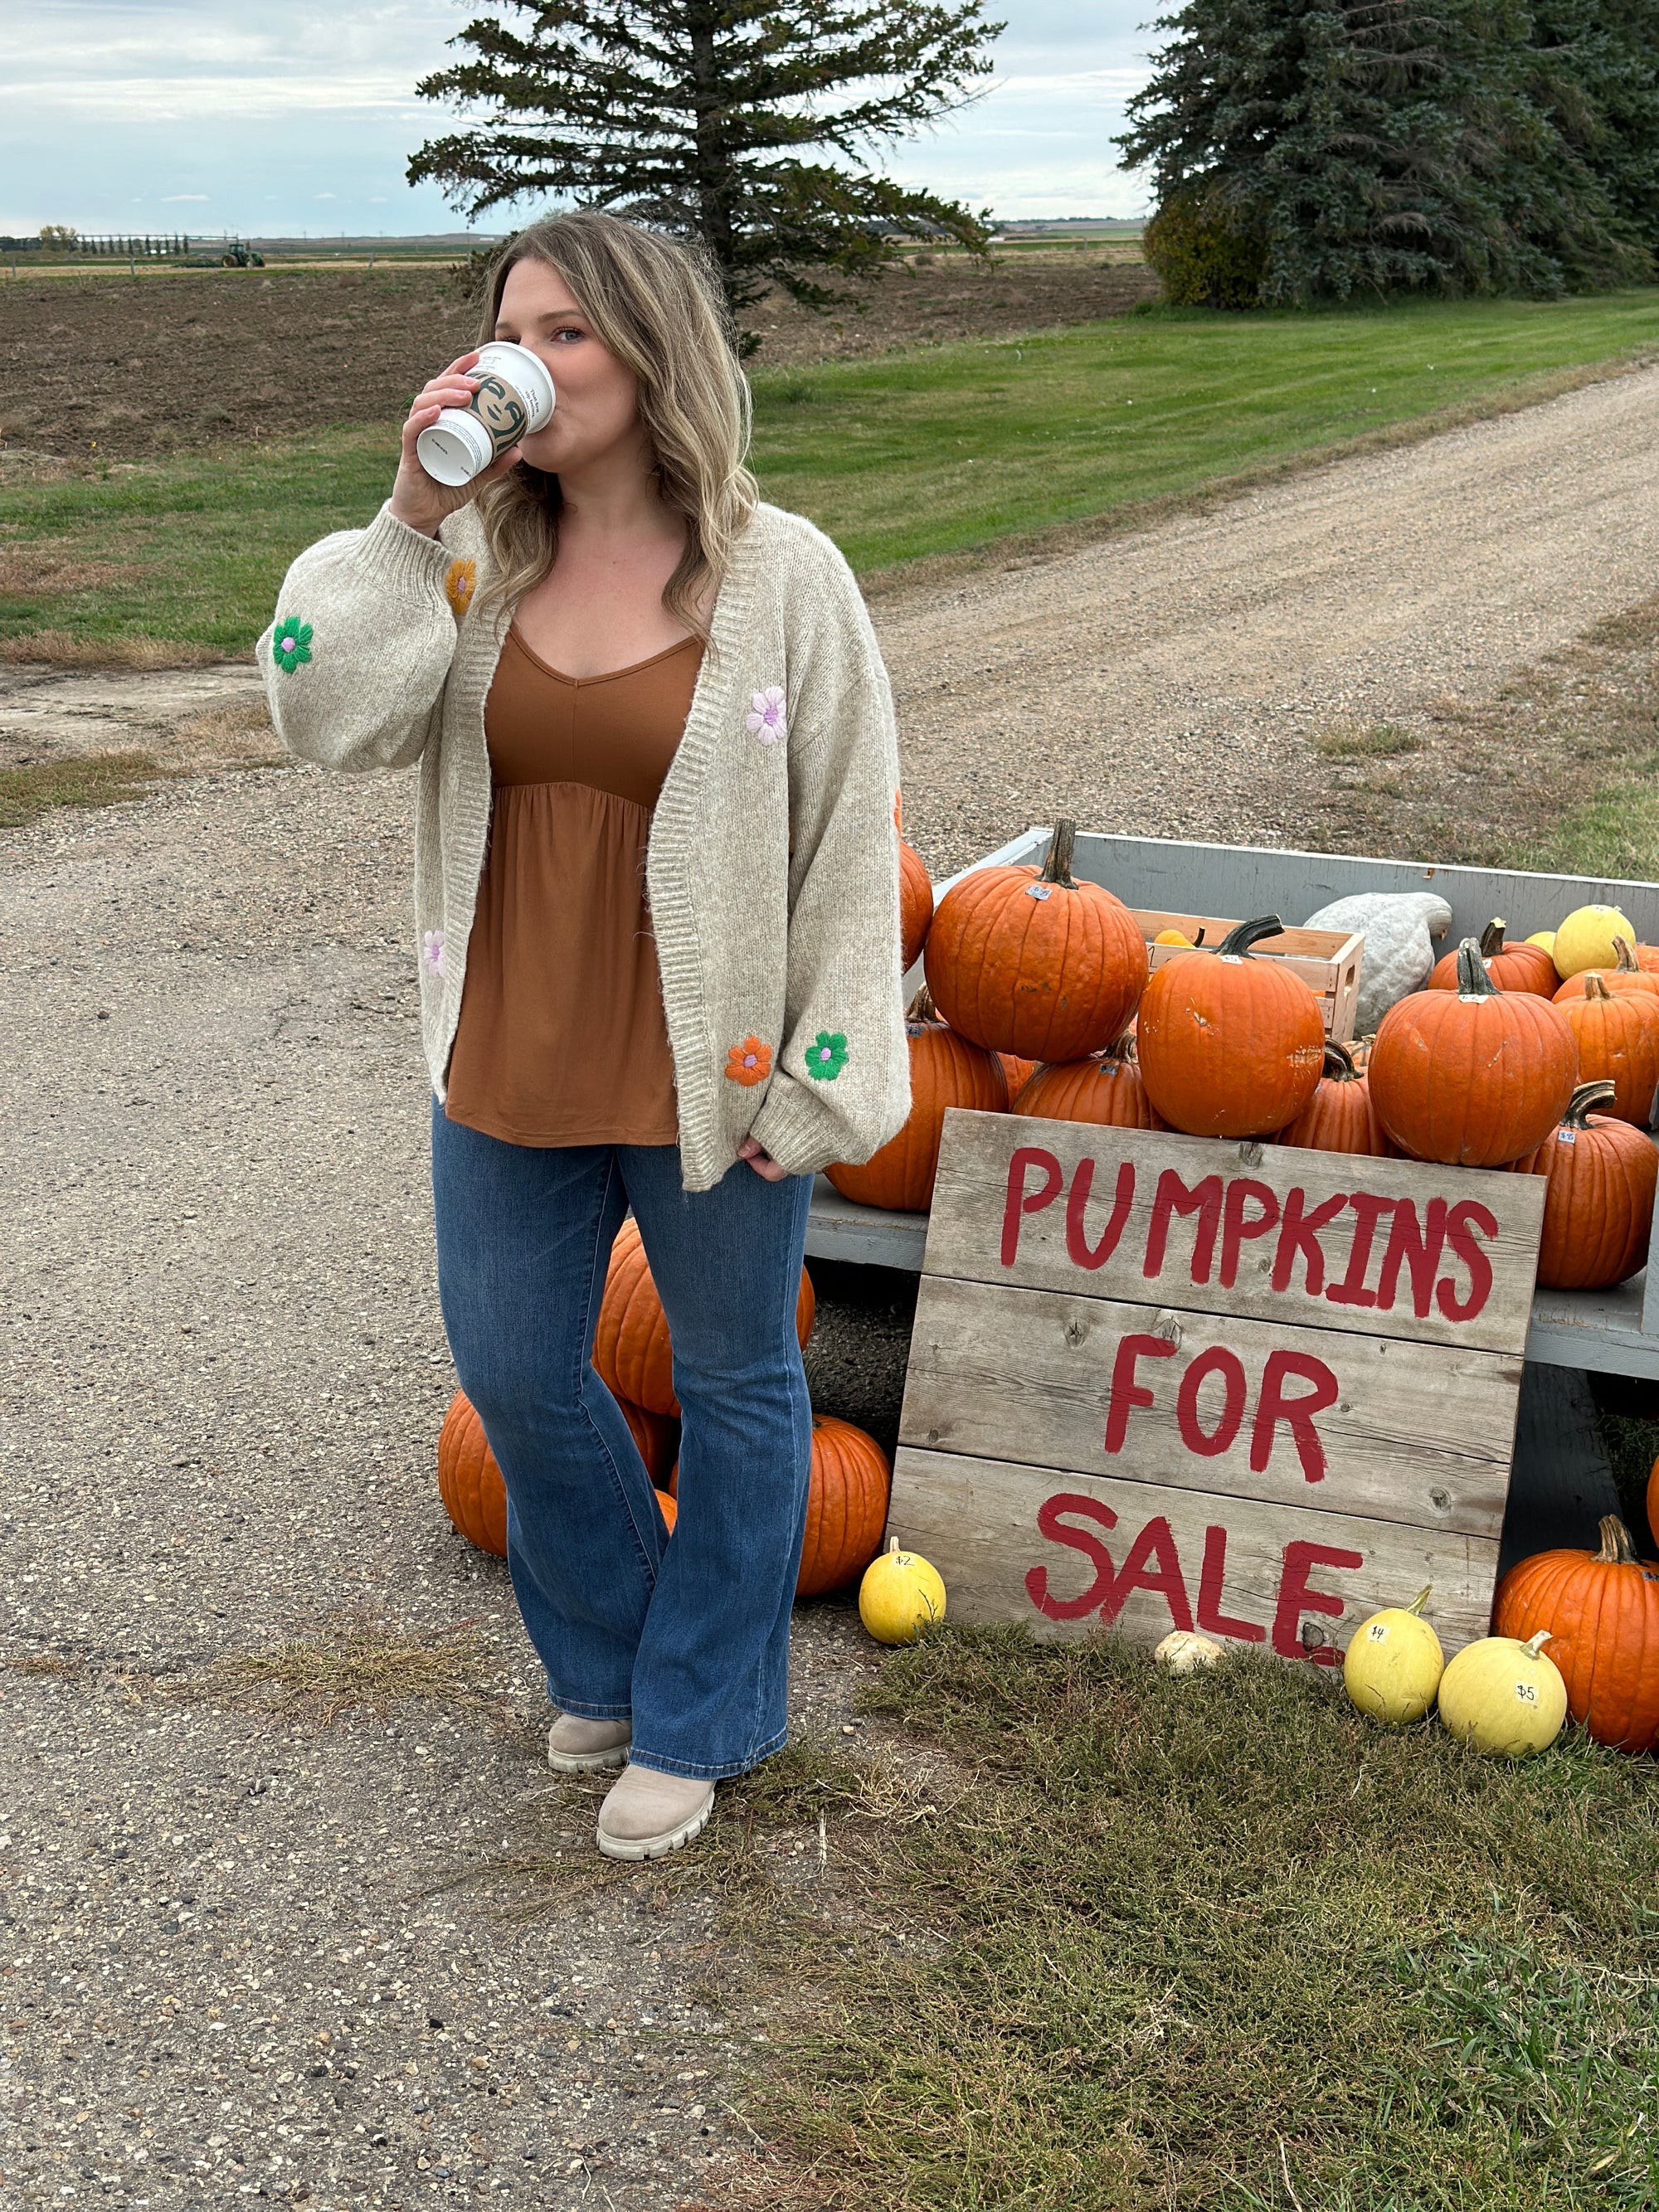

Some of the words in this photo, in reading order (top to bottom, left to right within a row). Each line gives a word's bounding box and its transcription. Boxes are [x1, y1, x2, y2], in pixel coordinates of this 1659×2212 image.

[1000, 1147, 1498, 1322] PUMPKINS
[1104, 1334, 1339, 1484] FOR
[896, 1556, 915, 1566] $2
[1024, 1493, 1364, 1667] SALE
[1371, 1626, 1384, 1639] $4
[1517, 1685, 1535, 1700] $5
